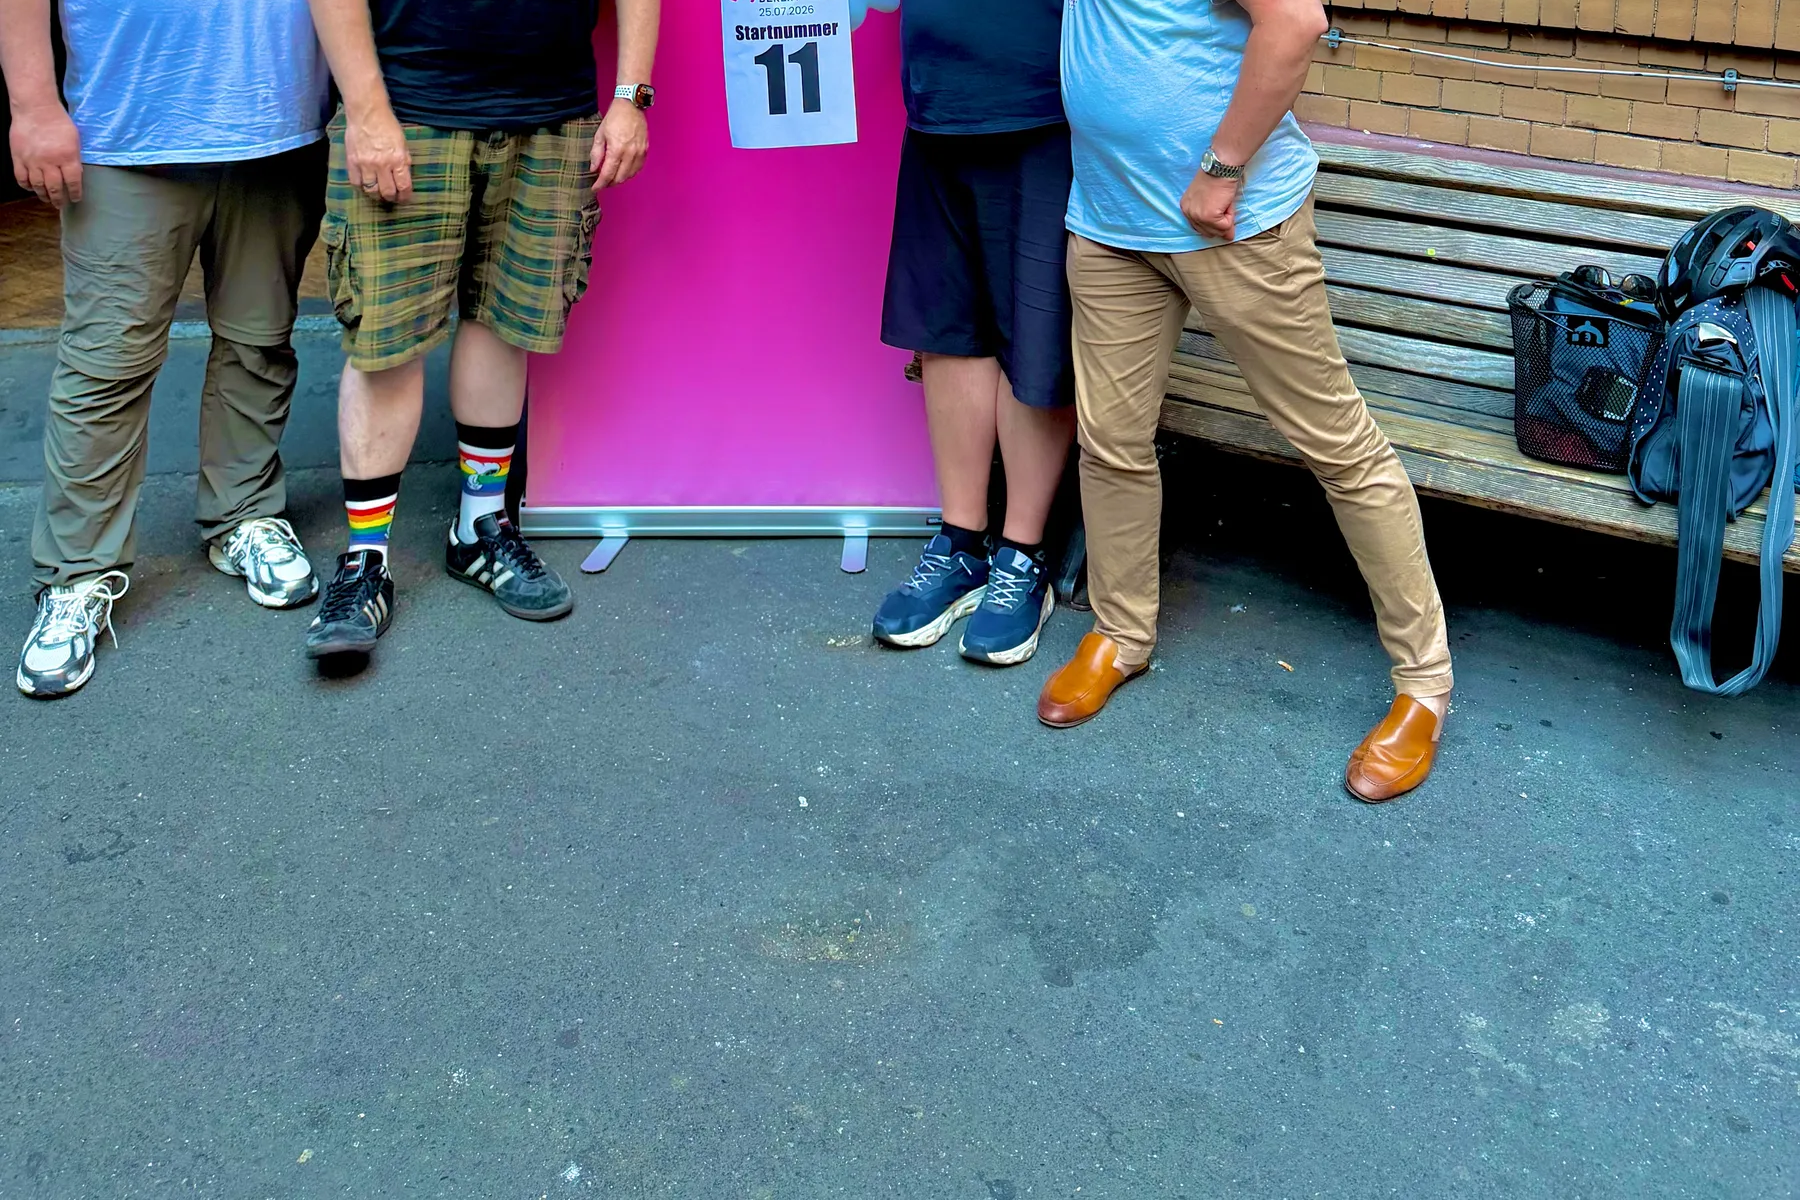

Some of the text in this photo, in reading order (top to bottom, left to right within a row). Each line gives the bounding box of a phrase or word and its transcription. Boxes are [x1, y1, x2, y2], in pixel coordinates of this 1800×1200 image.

[758, 4, 815, 17] 25.07.2026
[735, 22, 839, 41] Startnummer
[754, 41, 822, 115] 11
